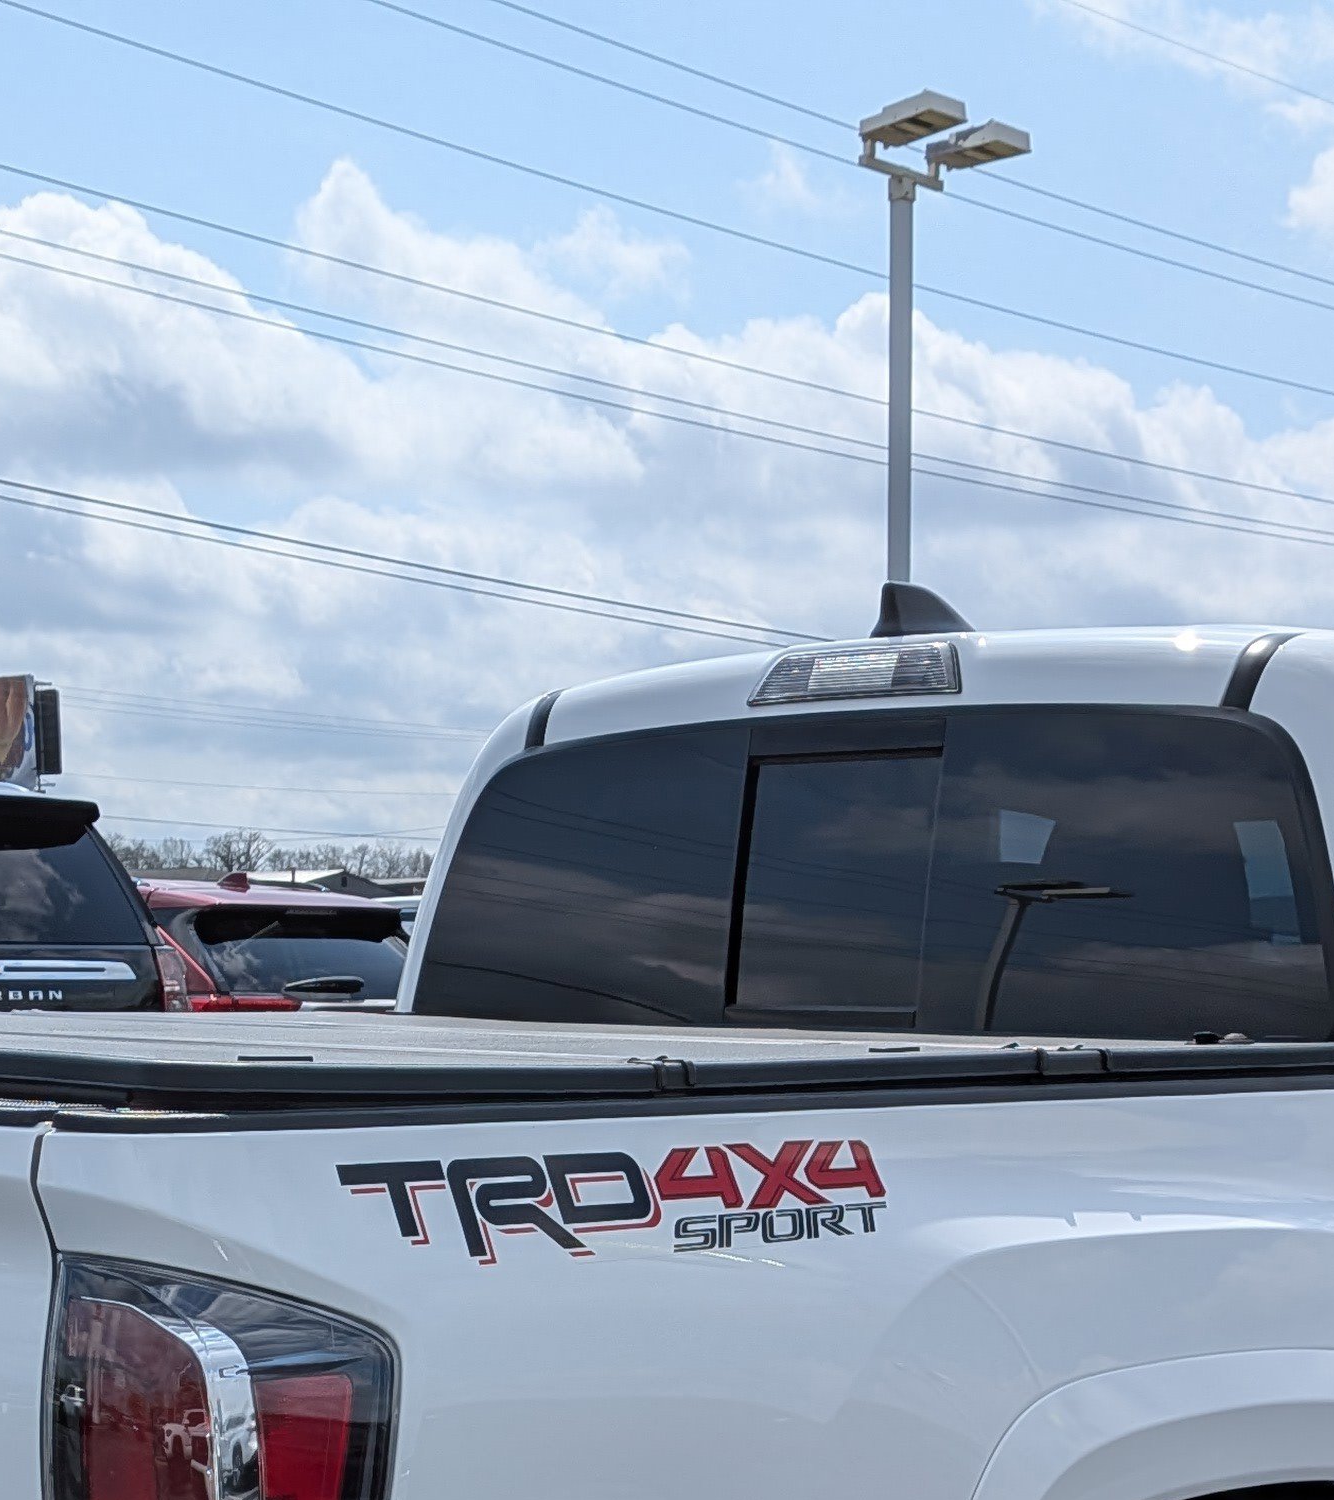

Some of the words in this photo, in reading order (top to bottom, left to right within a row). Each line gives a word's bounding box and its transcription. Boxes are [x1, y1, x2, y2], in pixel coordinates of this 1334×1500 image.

[335, 1150, 661, 1265] TRD
[653, 1139, 887, 1210] 4X4
[673, 1201, 887, 1253] SPORT
